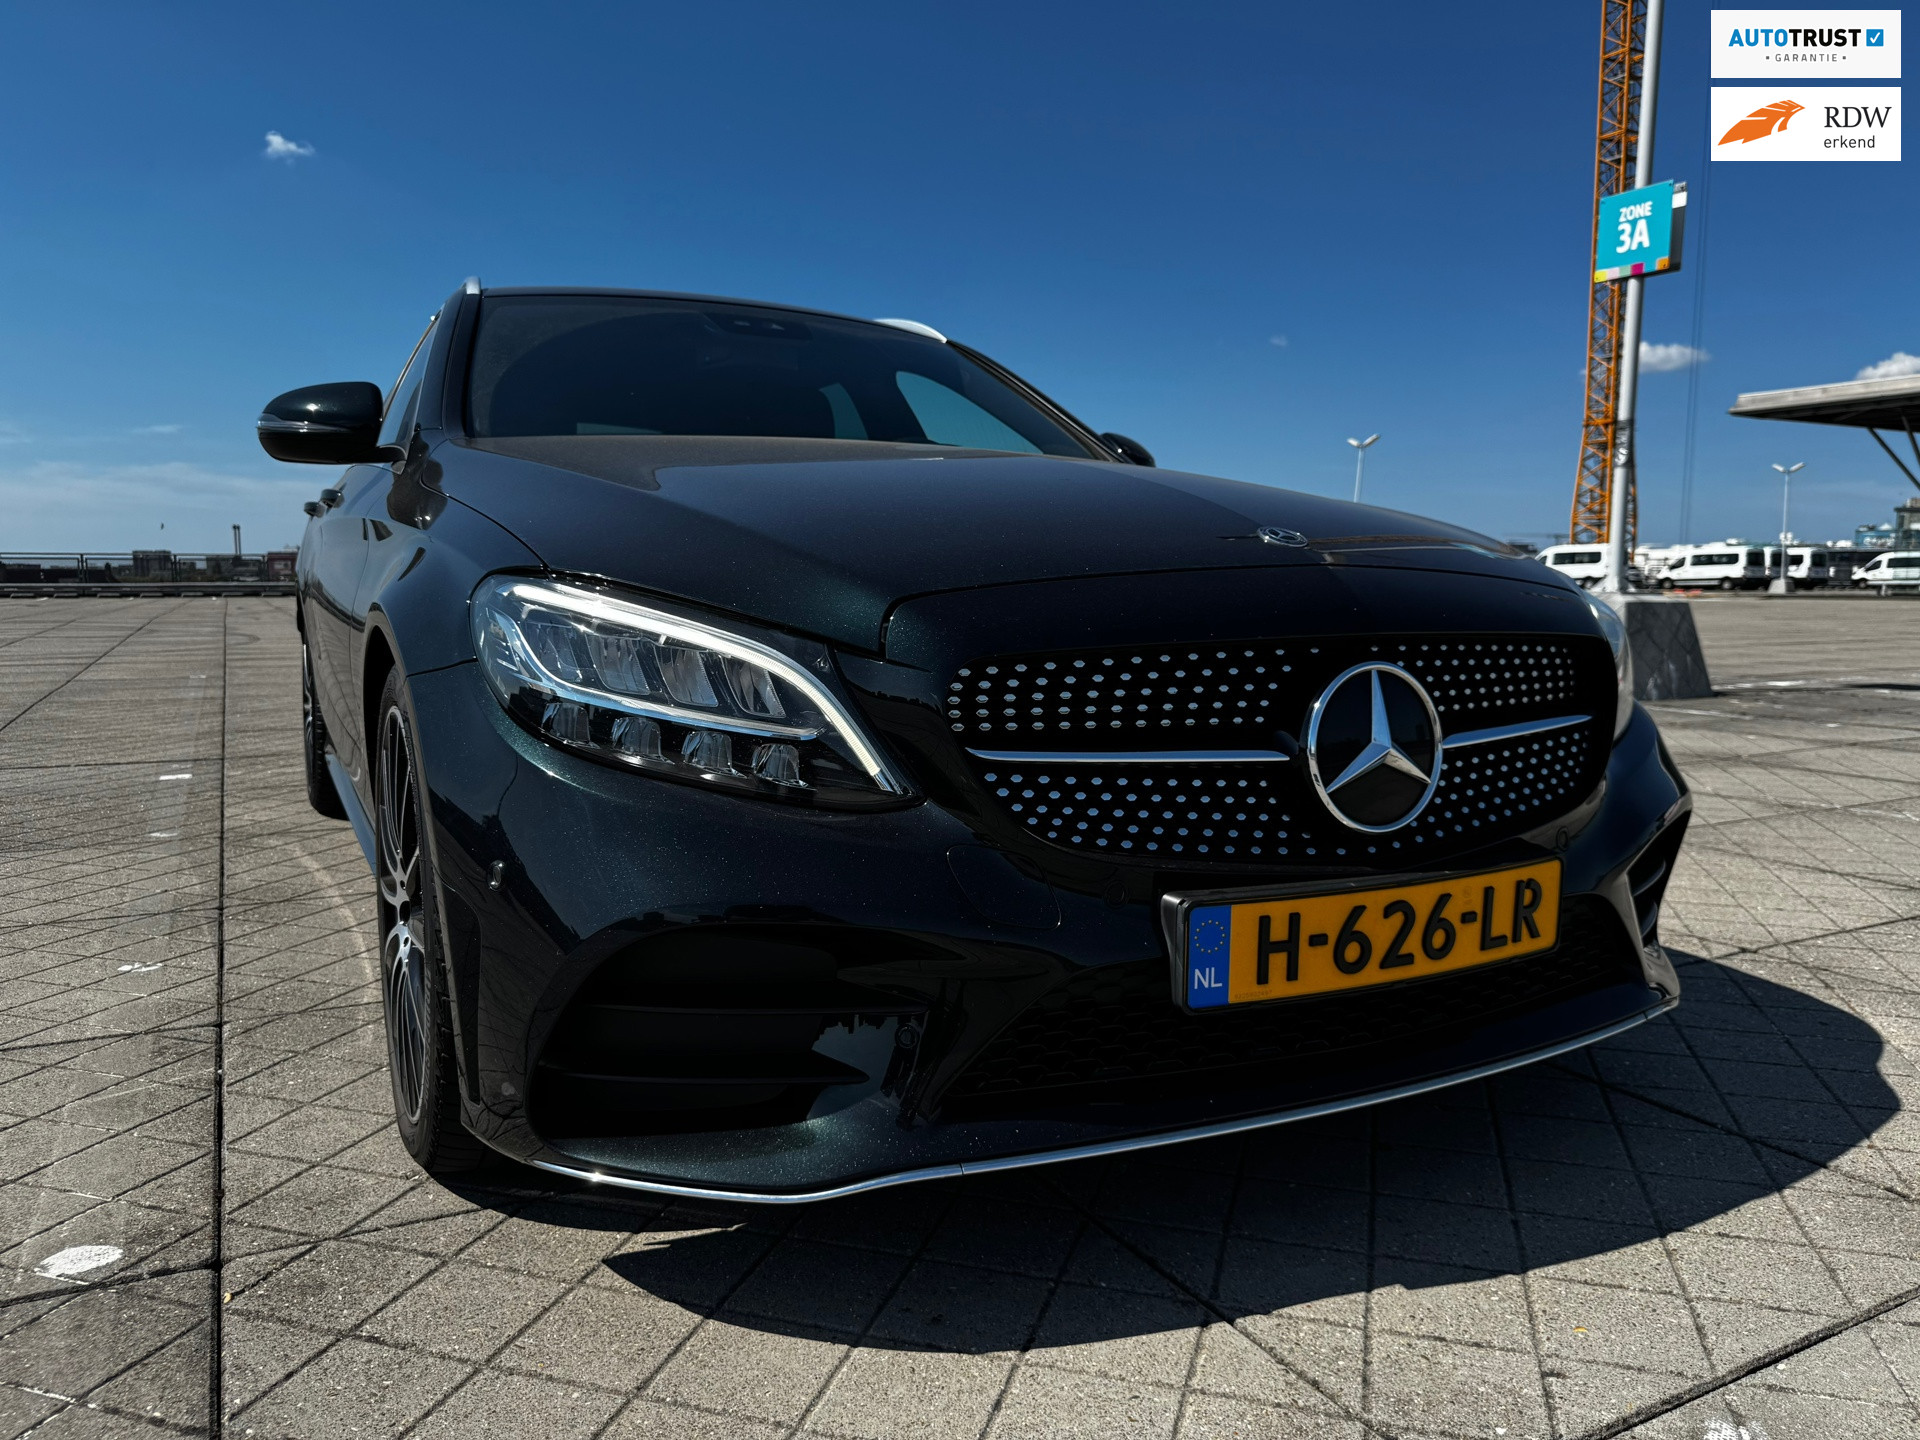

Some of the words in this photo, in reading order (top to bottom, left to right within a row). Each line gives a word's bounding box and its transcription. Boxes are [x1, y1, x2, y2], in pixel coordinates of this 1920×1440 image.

[1619, 200, 1653, 223] ZONE
[1616, 218, 1650, 253] 3A
[1256, 876, 1542, 986] H-626-LR
[1193, 966, 1223, 990] NL
